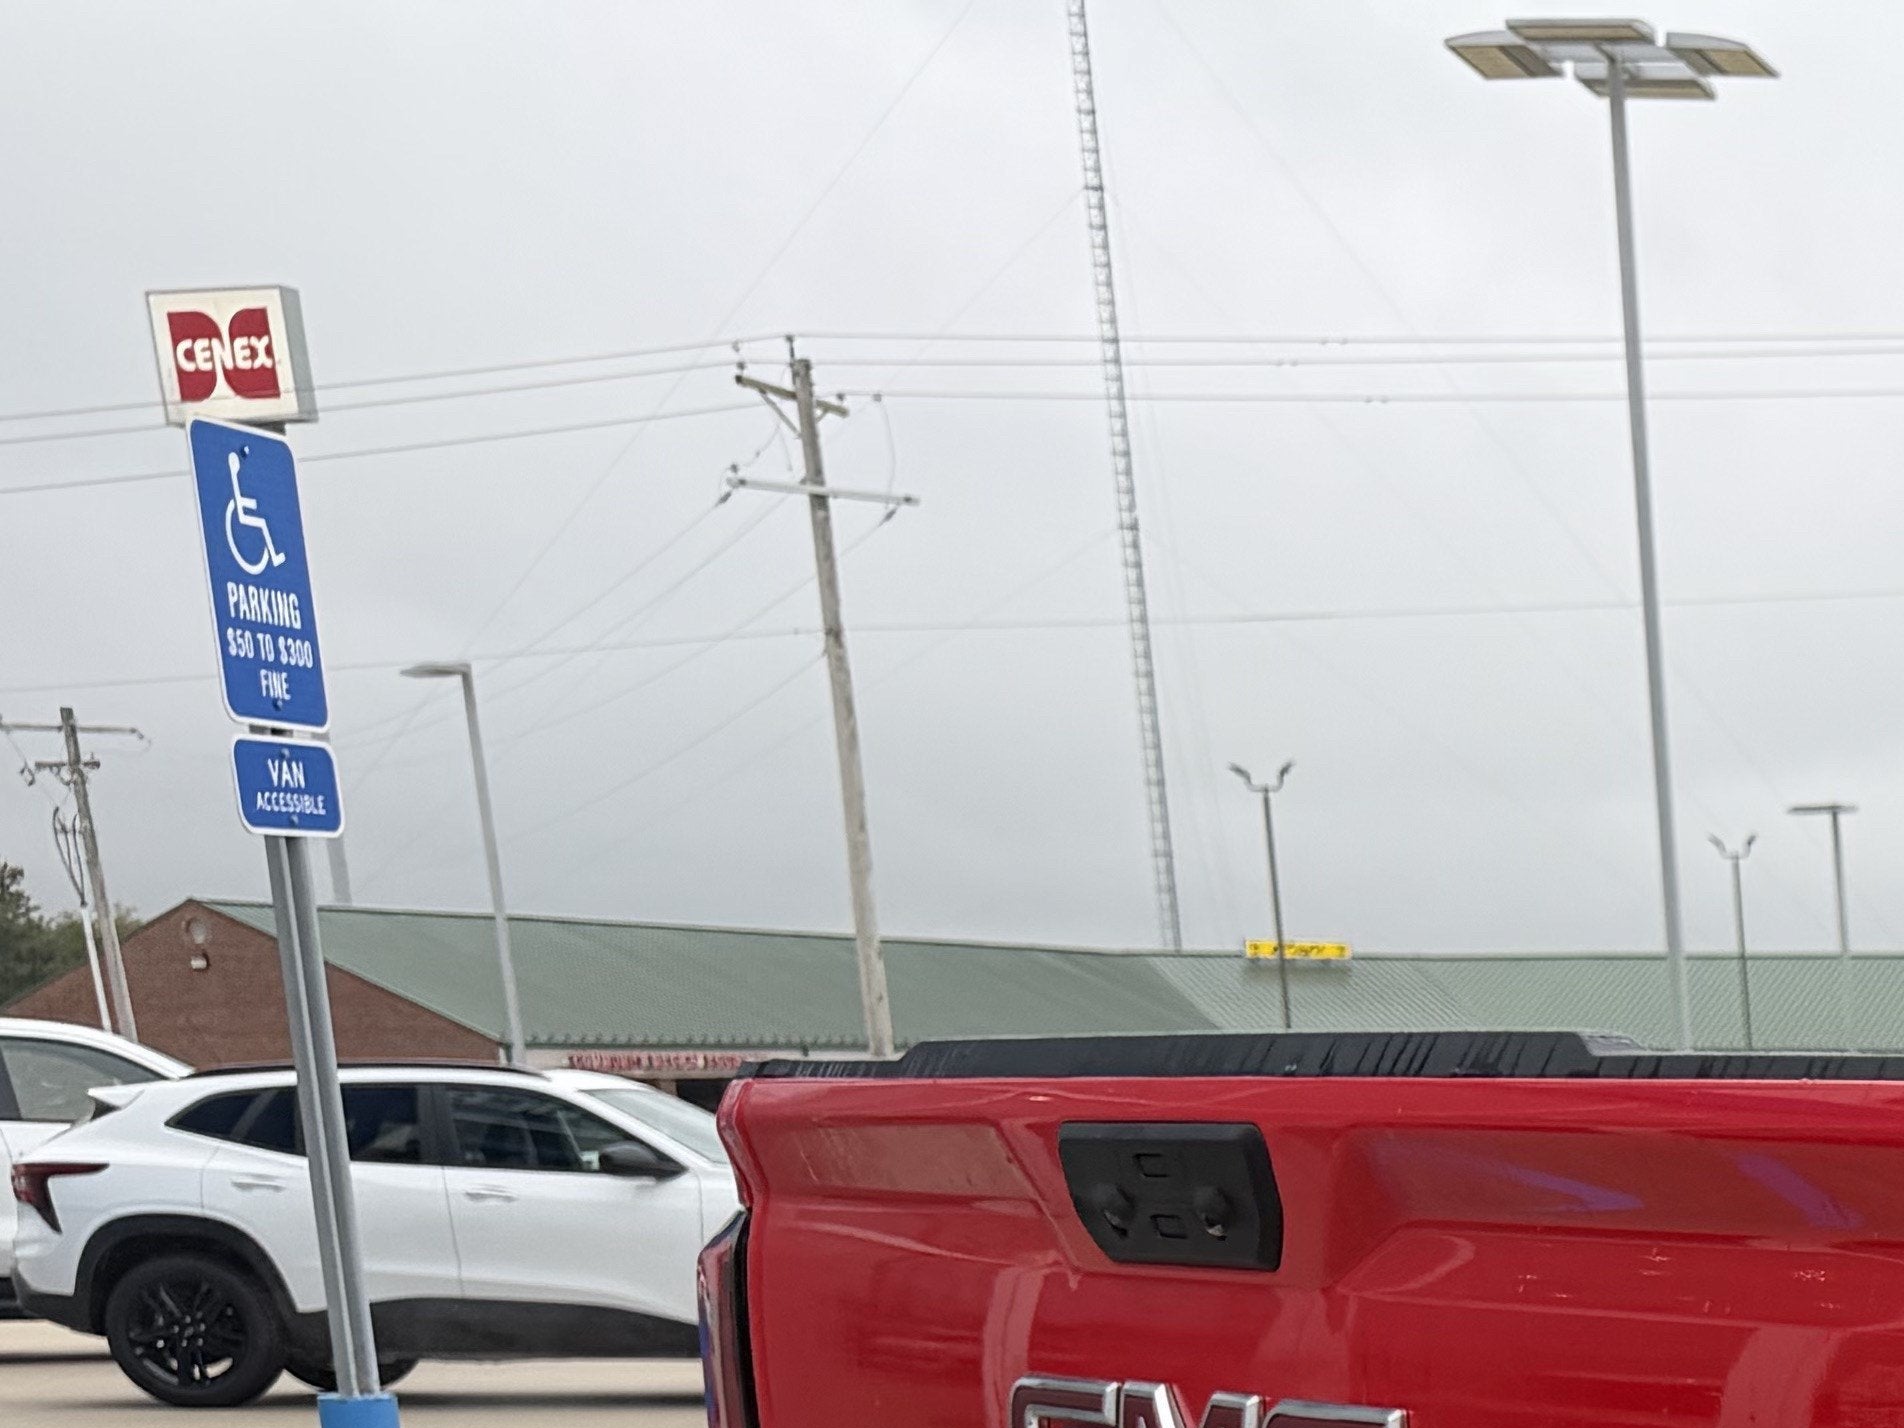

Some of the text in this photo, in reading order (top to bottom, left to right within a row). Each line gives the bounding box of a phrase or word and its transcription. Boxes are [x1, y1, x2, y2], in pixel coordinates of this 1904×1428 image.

[176, 335, 273, 372] CENEX
[226, 581, 302, 630] PARKING
[226, 627, 314, 669] $50 TO $300
[259, 668, 292, 700] FINE
[267, 758, 306, 789] VAN
[256, 791, 327, 816] ACCESSIBLE
